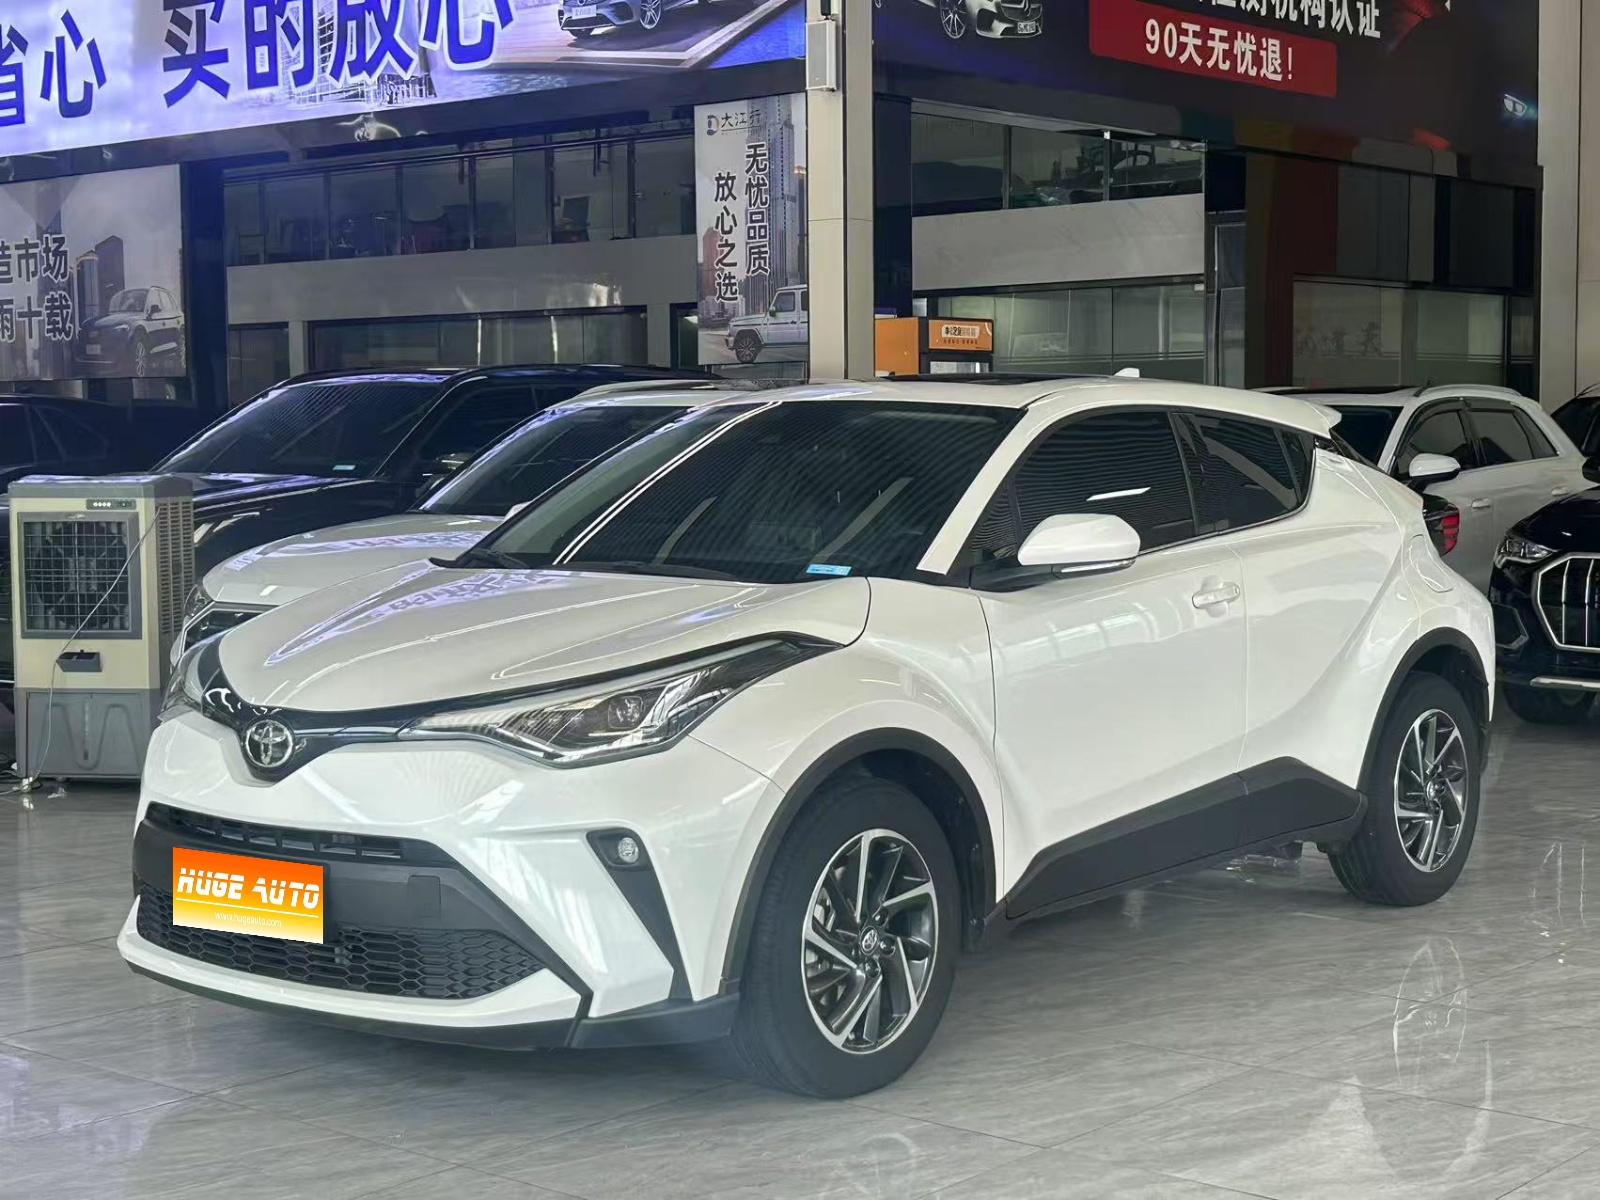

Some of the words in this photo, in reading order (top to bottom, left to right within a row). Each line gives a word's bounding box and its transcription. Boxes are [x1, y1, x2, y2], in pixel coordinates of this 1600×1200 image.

[162, 0, 514, 108] 买的放心
[1210, 0, 1381, 38] 机构认证
[714, 172, 739, 302] 放心之选
[745, 142, 770, 276] 无忧品质
